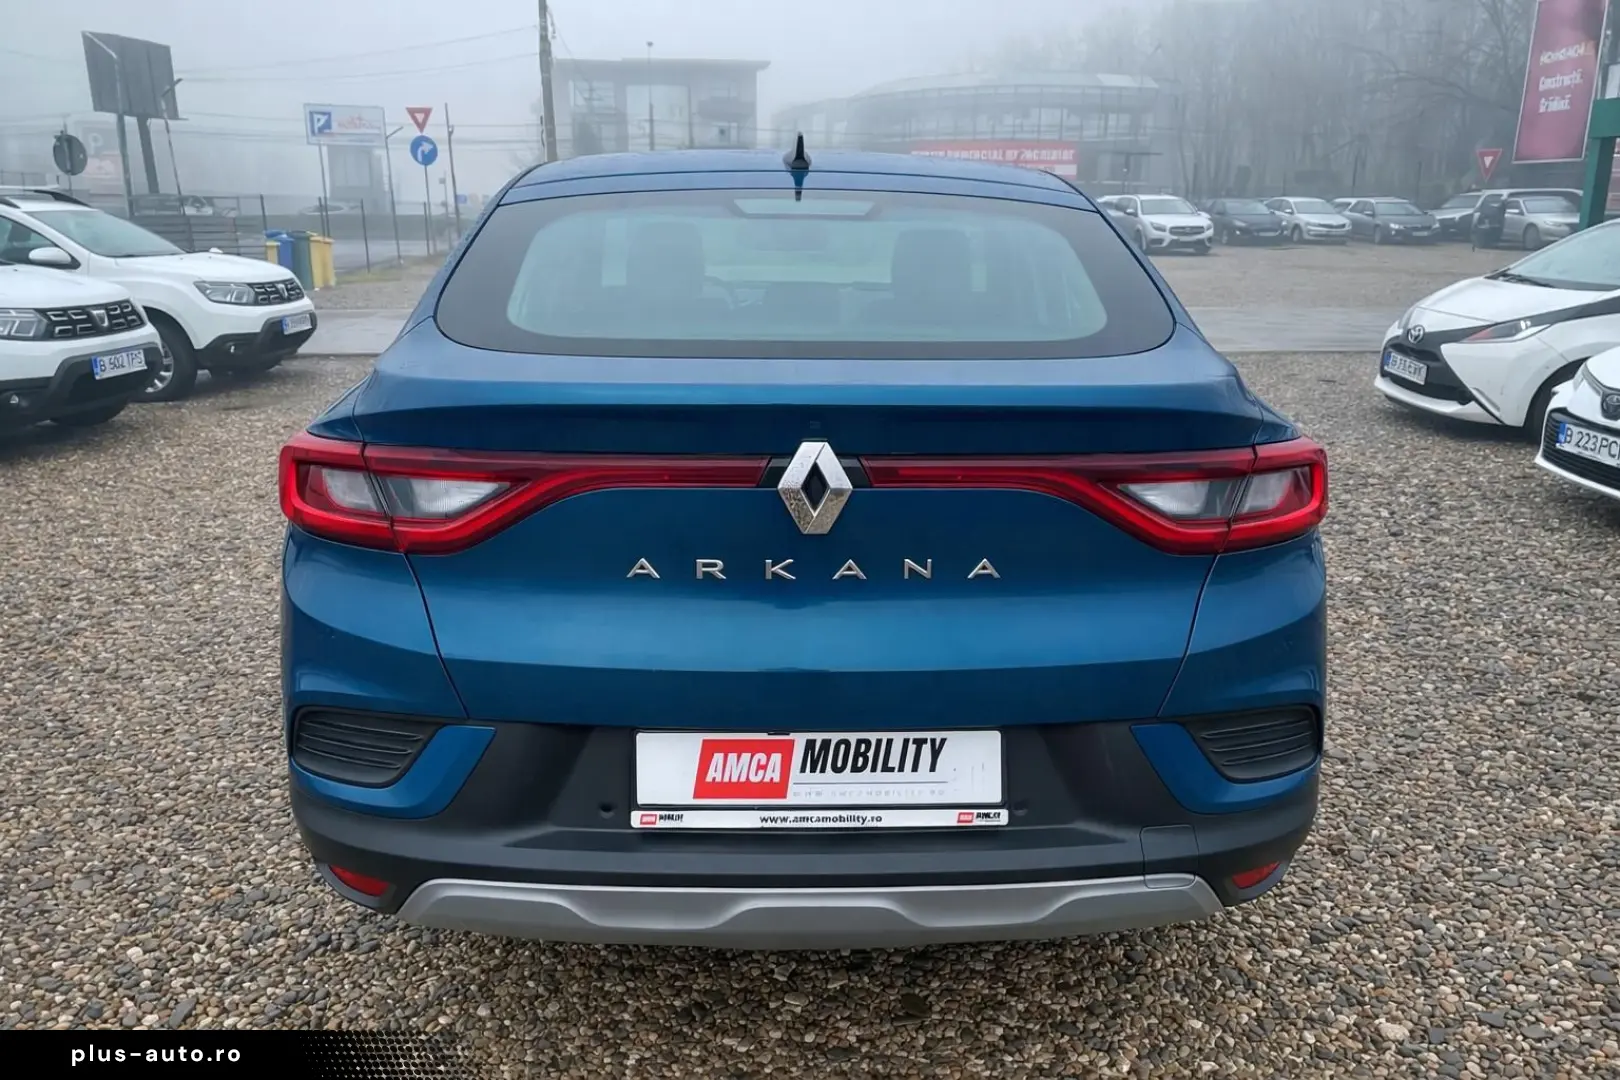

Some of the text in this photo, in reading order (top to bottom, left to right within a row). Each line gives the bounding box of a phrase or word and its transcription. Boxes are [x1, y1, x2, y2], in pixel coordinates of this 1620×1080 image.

[1565, 427, 1573, 444] B
[626, 557, 1001, 580] ARKANA
[705, 737, 948, 783] AMCA MOBILITY
[759, 814, 883, 826] www.amcamobility.ro
